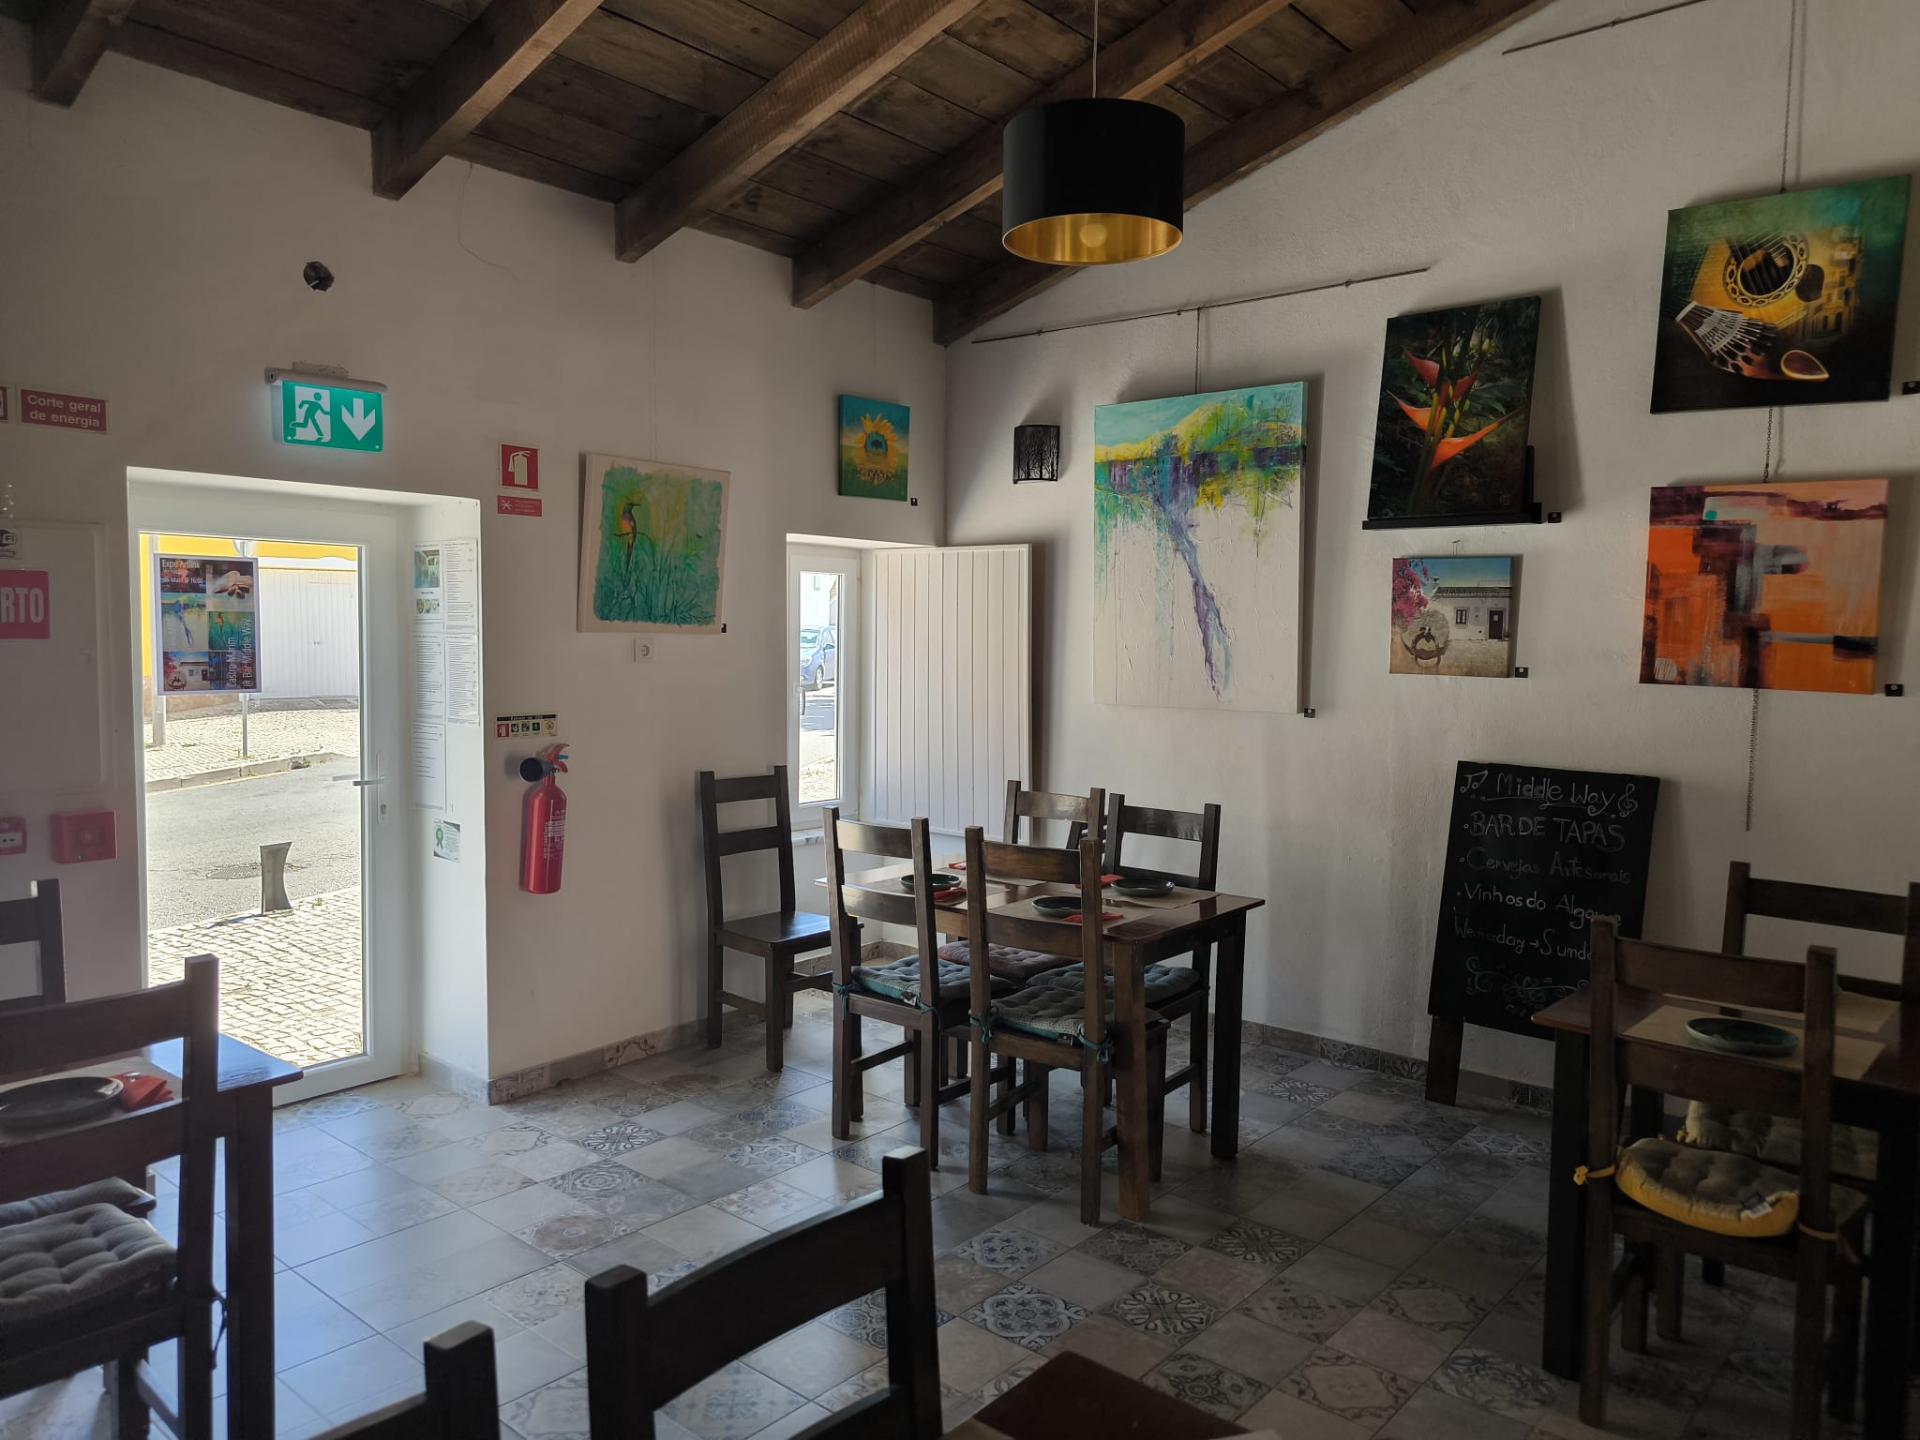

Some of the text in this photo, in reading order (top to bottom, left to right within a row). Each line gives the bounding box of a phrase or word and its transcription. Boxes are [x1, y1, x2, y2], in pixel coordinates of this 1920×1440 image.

[27, 394, 101, 413] Corte geral
[30, 410, 100, 428] de energia
[1496, 772, 1616, 816] Middle Way
[1468, 810, 1626, 852] BAR DE TAPAS
[1463, 882, 1524, 907] Vinhos
[1526, 890, 1546, 910] do
